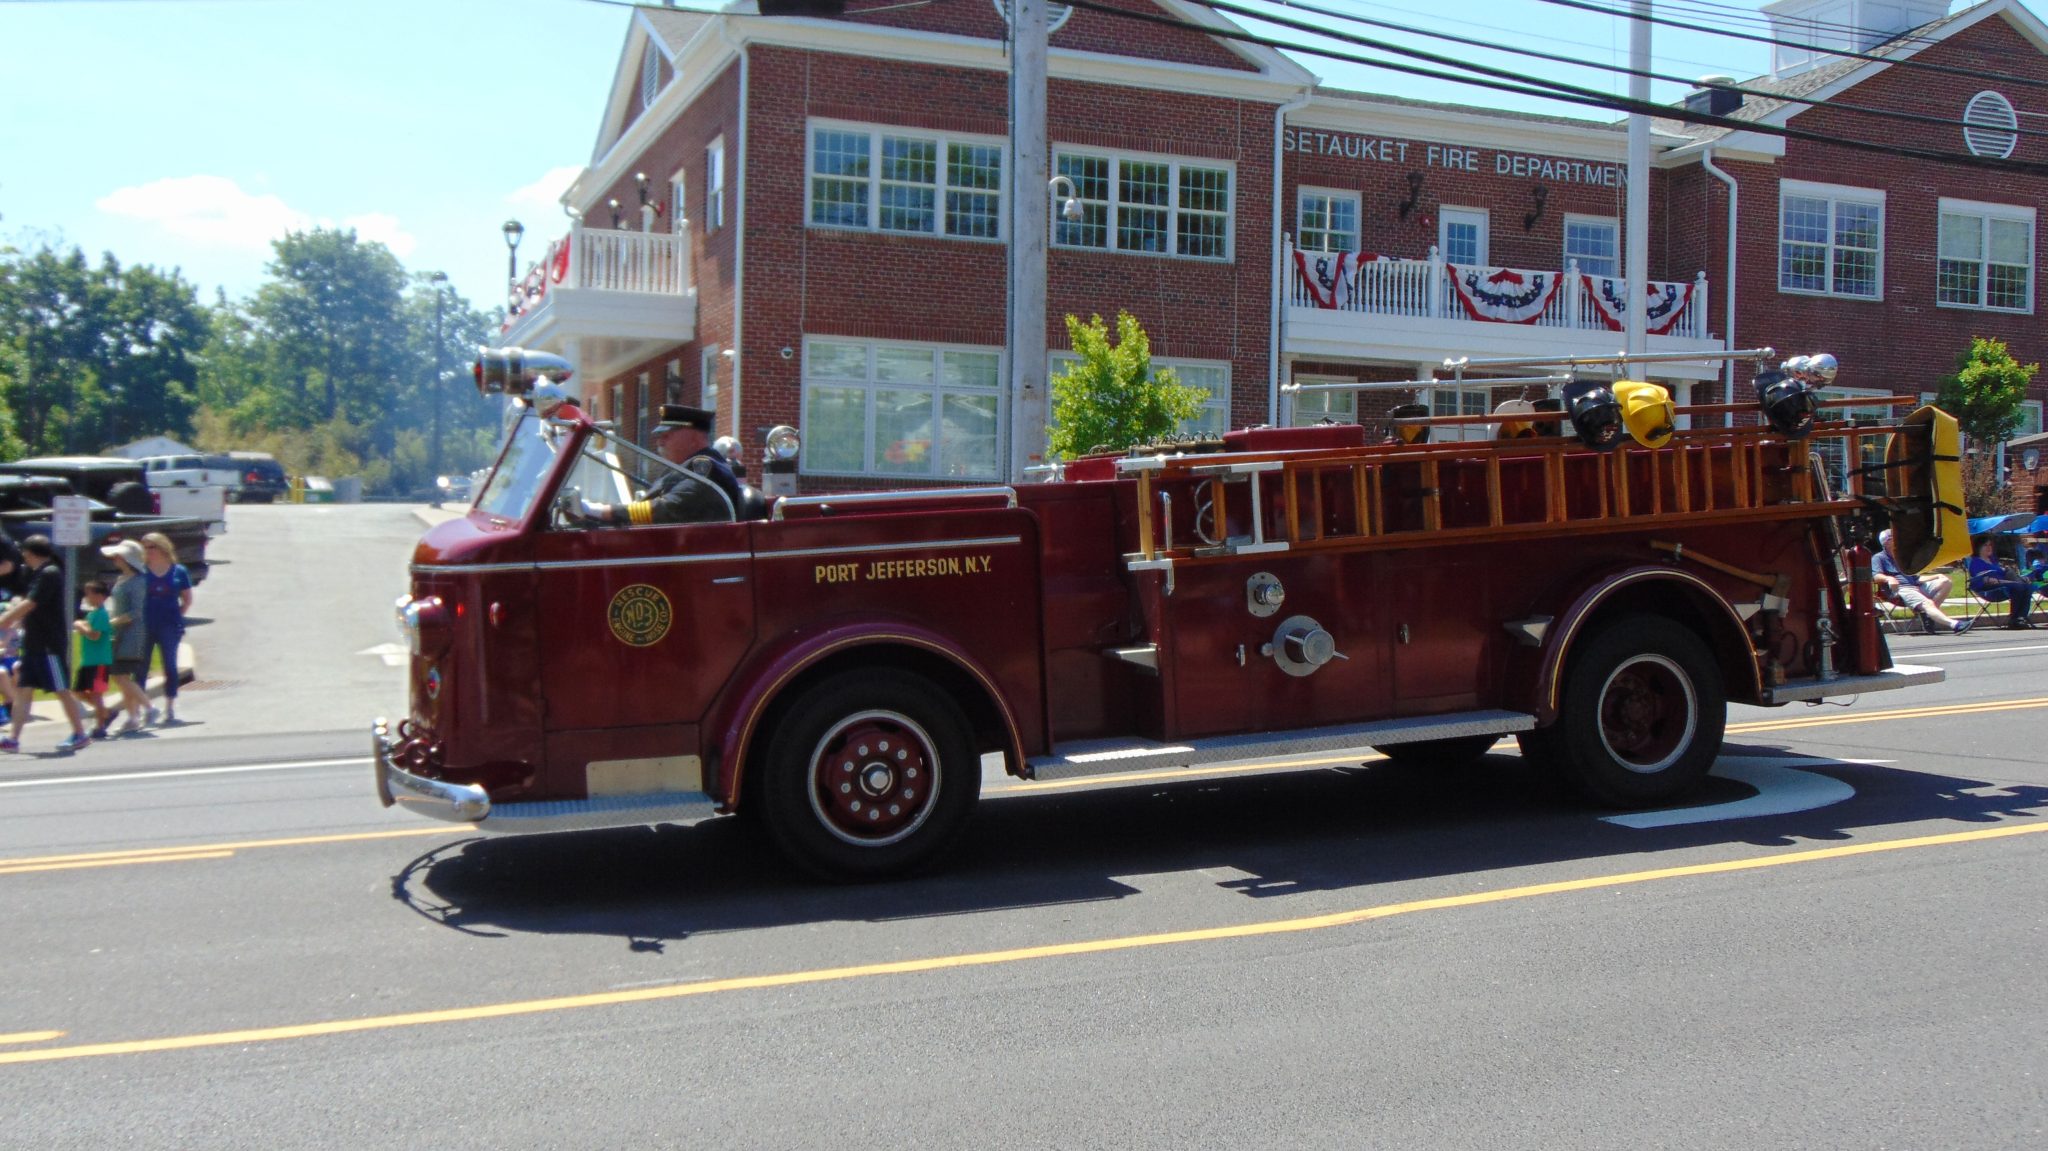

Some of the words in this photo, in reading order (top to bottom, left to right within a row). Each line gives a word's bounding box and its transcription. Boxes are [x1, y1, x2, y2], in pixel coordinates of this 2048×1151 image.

[1284, 129, 1409, 163] SETAUKET
[1427, 146, 1479, 172] FIRE
[1497, 154, 1629, 188] DEPARTMEN
[815, 563, 859, 583] PORT
[866, 557, 963, 580] JEFFERSON,
[965, 555, 992, 573] N.Y.
[615, 587, 660, 607] RESCUE
